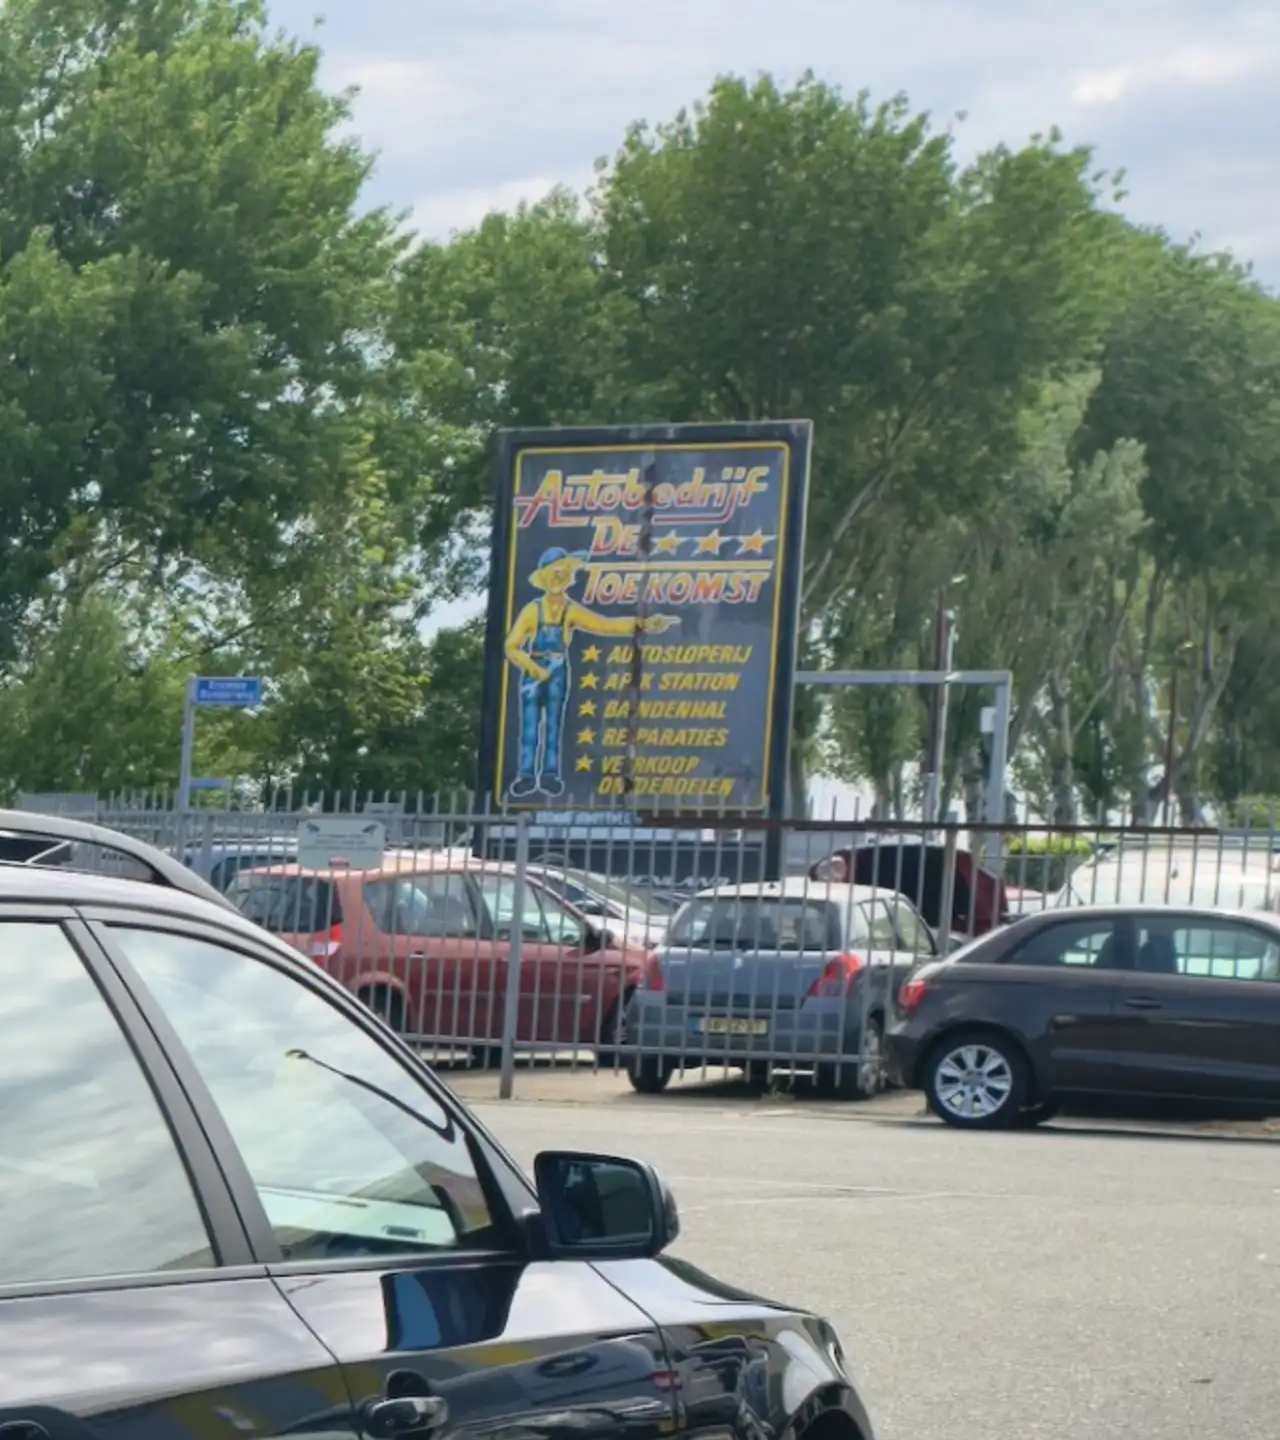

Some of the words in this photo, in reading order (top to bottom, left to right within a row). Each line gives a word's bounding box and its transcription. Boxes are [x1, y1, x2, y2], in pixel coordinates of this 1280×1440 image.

[590, 516, 642, 556] DE
[581, 560, 774, 604] TOEKOMST
[607, 645, 753, 664] AUTOSLOPERIJ
[603, 672, 655, 691] APK
[658, 672, 740, 691] STATION
[604, 700, 727, 719] BANDENHAL
[602, 728, 729, 746] REPARATIES
[601, 755, 700, 774] VERKOOP
